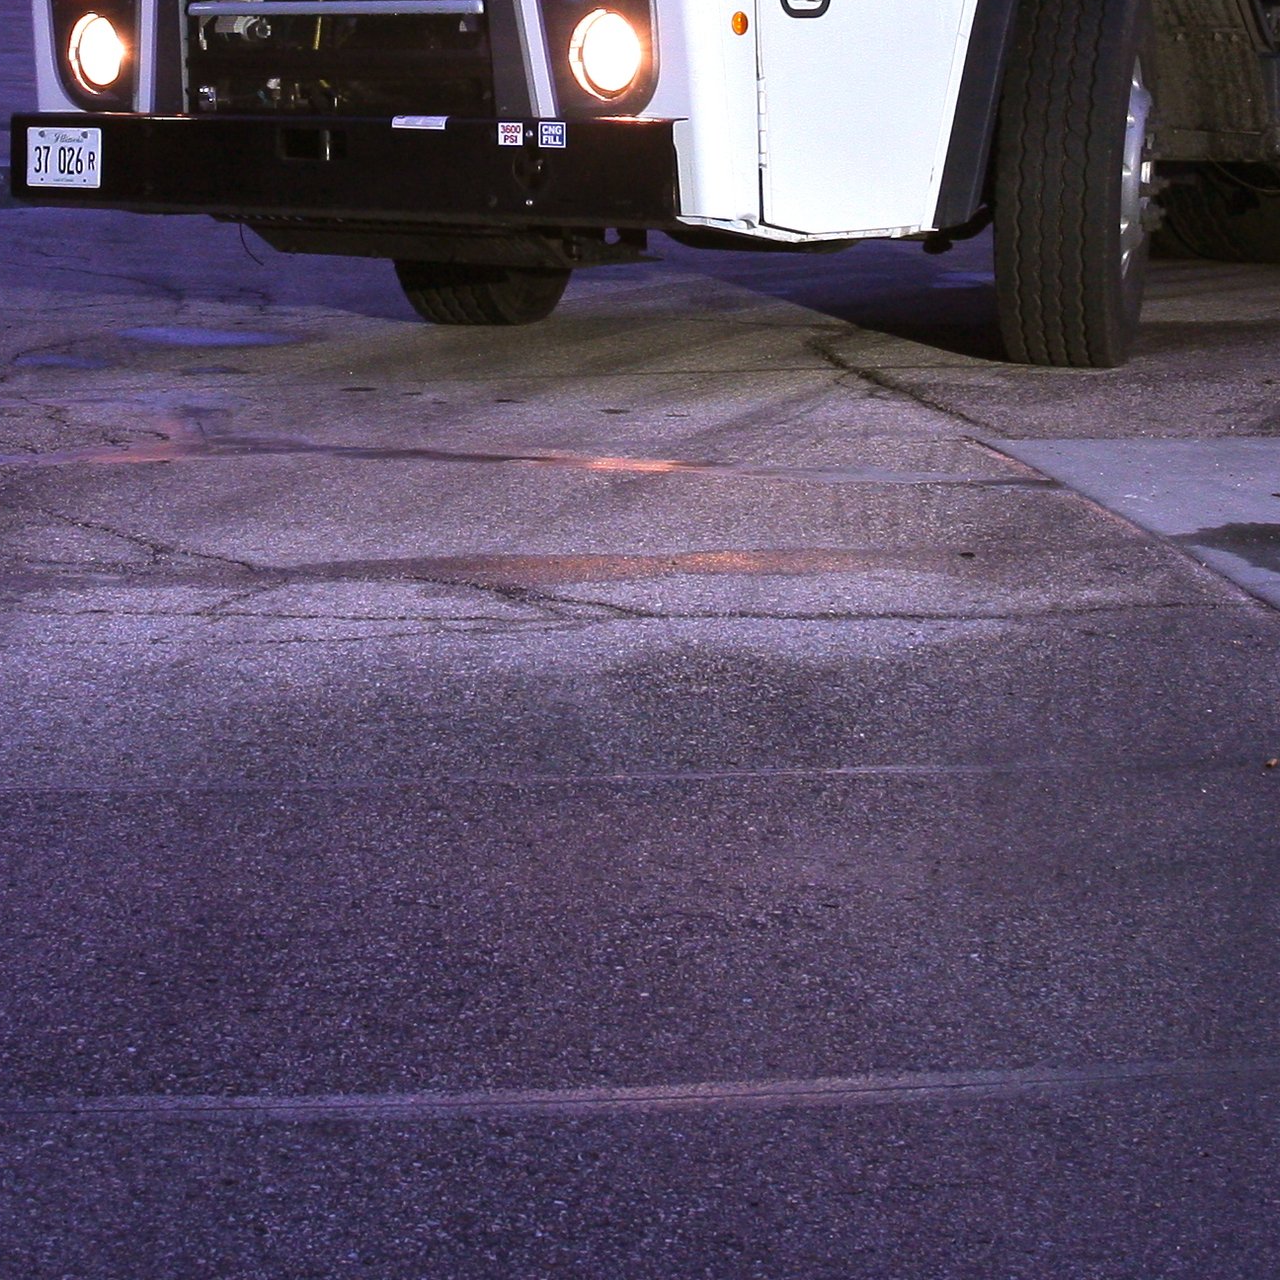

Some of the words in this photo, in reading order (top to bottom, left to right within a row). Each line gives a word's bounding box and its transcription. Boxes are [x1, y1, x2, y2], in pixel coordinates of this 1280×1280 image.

[500, 124, 521, 134] 3600
[541, 125, 562, 135] CNG
[503, 134, 518, 144] PSI
[542, 135, 562, 145] FILL
[34, 145, 51, 174] 37
[58, 146, 84, 175] 026
[88, 151, 96, 171] R
